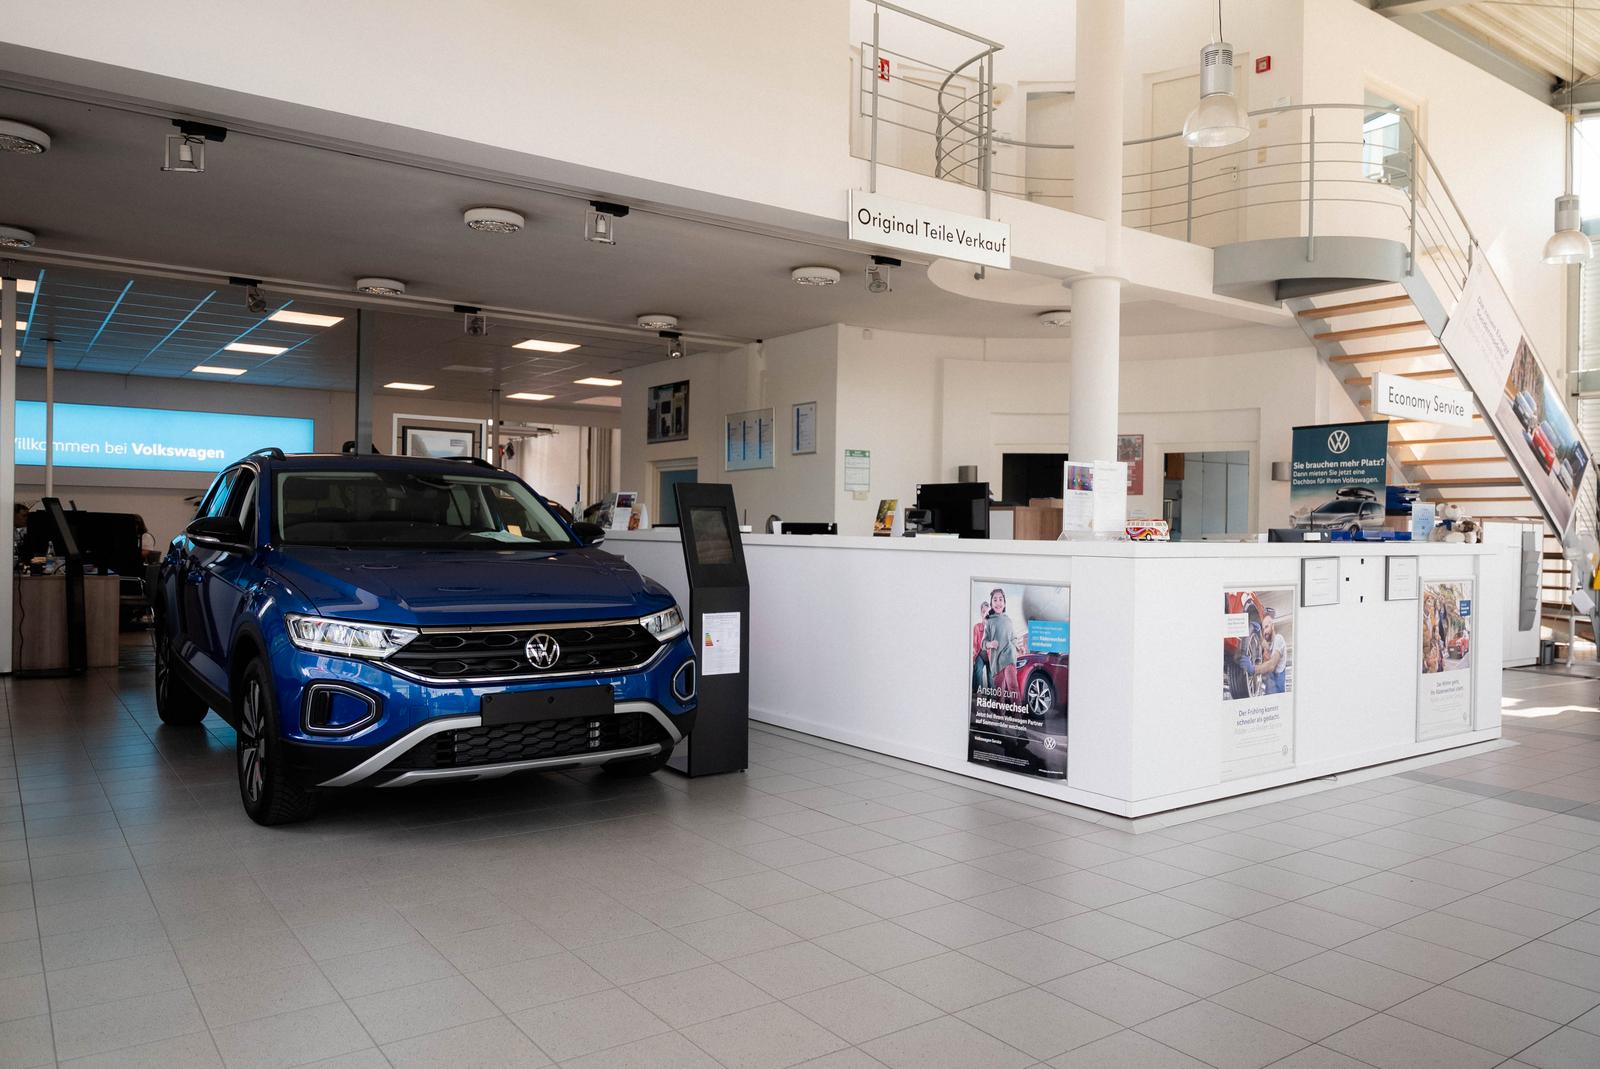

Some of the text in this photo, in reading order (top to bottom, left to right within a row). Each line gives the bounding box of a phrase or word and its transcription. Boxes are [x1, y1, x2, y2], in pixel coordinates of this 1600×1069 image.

[858, 208, 1007, 253] Original Teile Verkauf
[1388, 386, 1465, 416] Economy Service
[15, 437, 225, 461] illkommen bei Volkswagen
[1293, 458, 1385, 470] Sie brauchen mehr Platz?
[1338, 469, 1352, 477] jetzt
[977, 685, 1018, 699] Anstoß zum
[976, 697, 1029, 714] Räderwechsel
